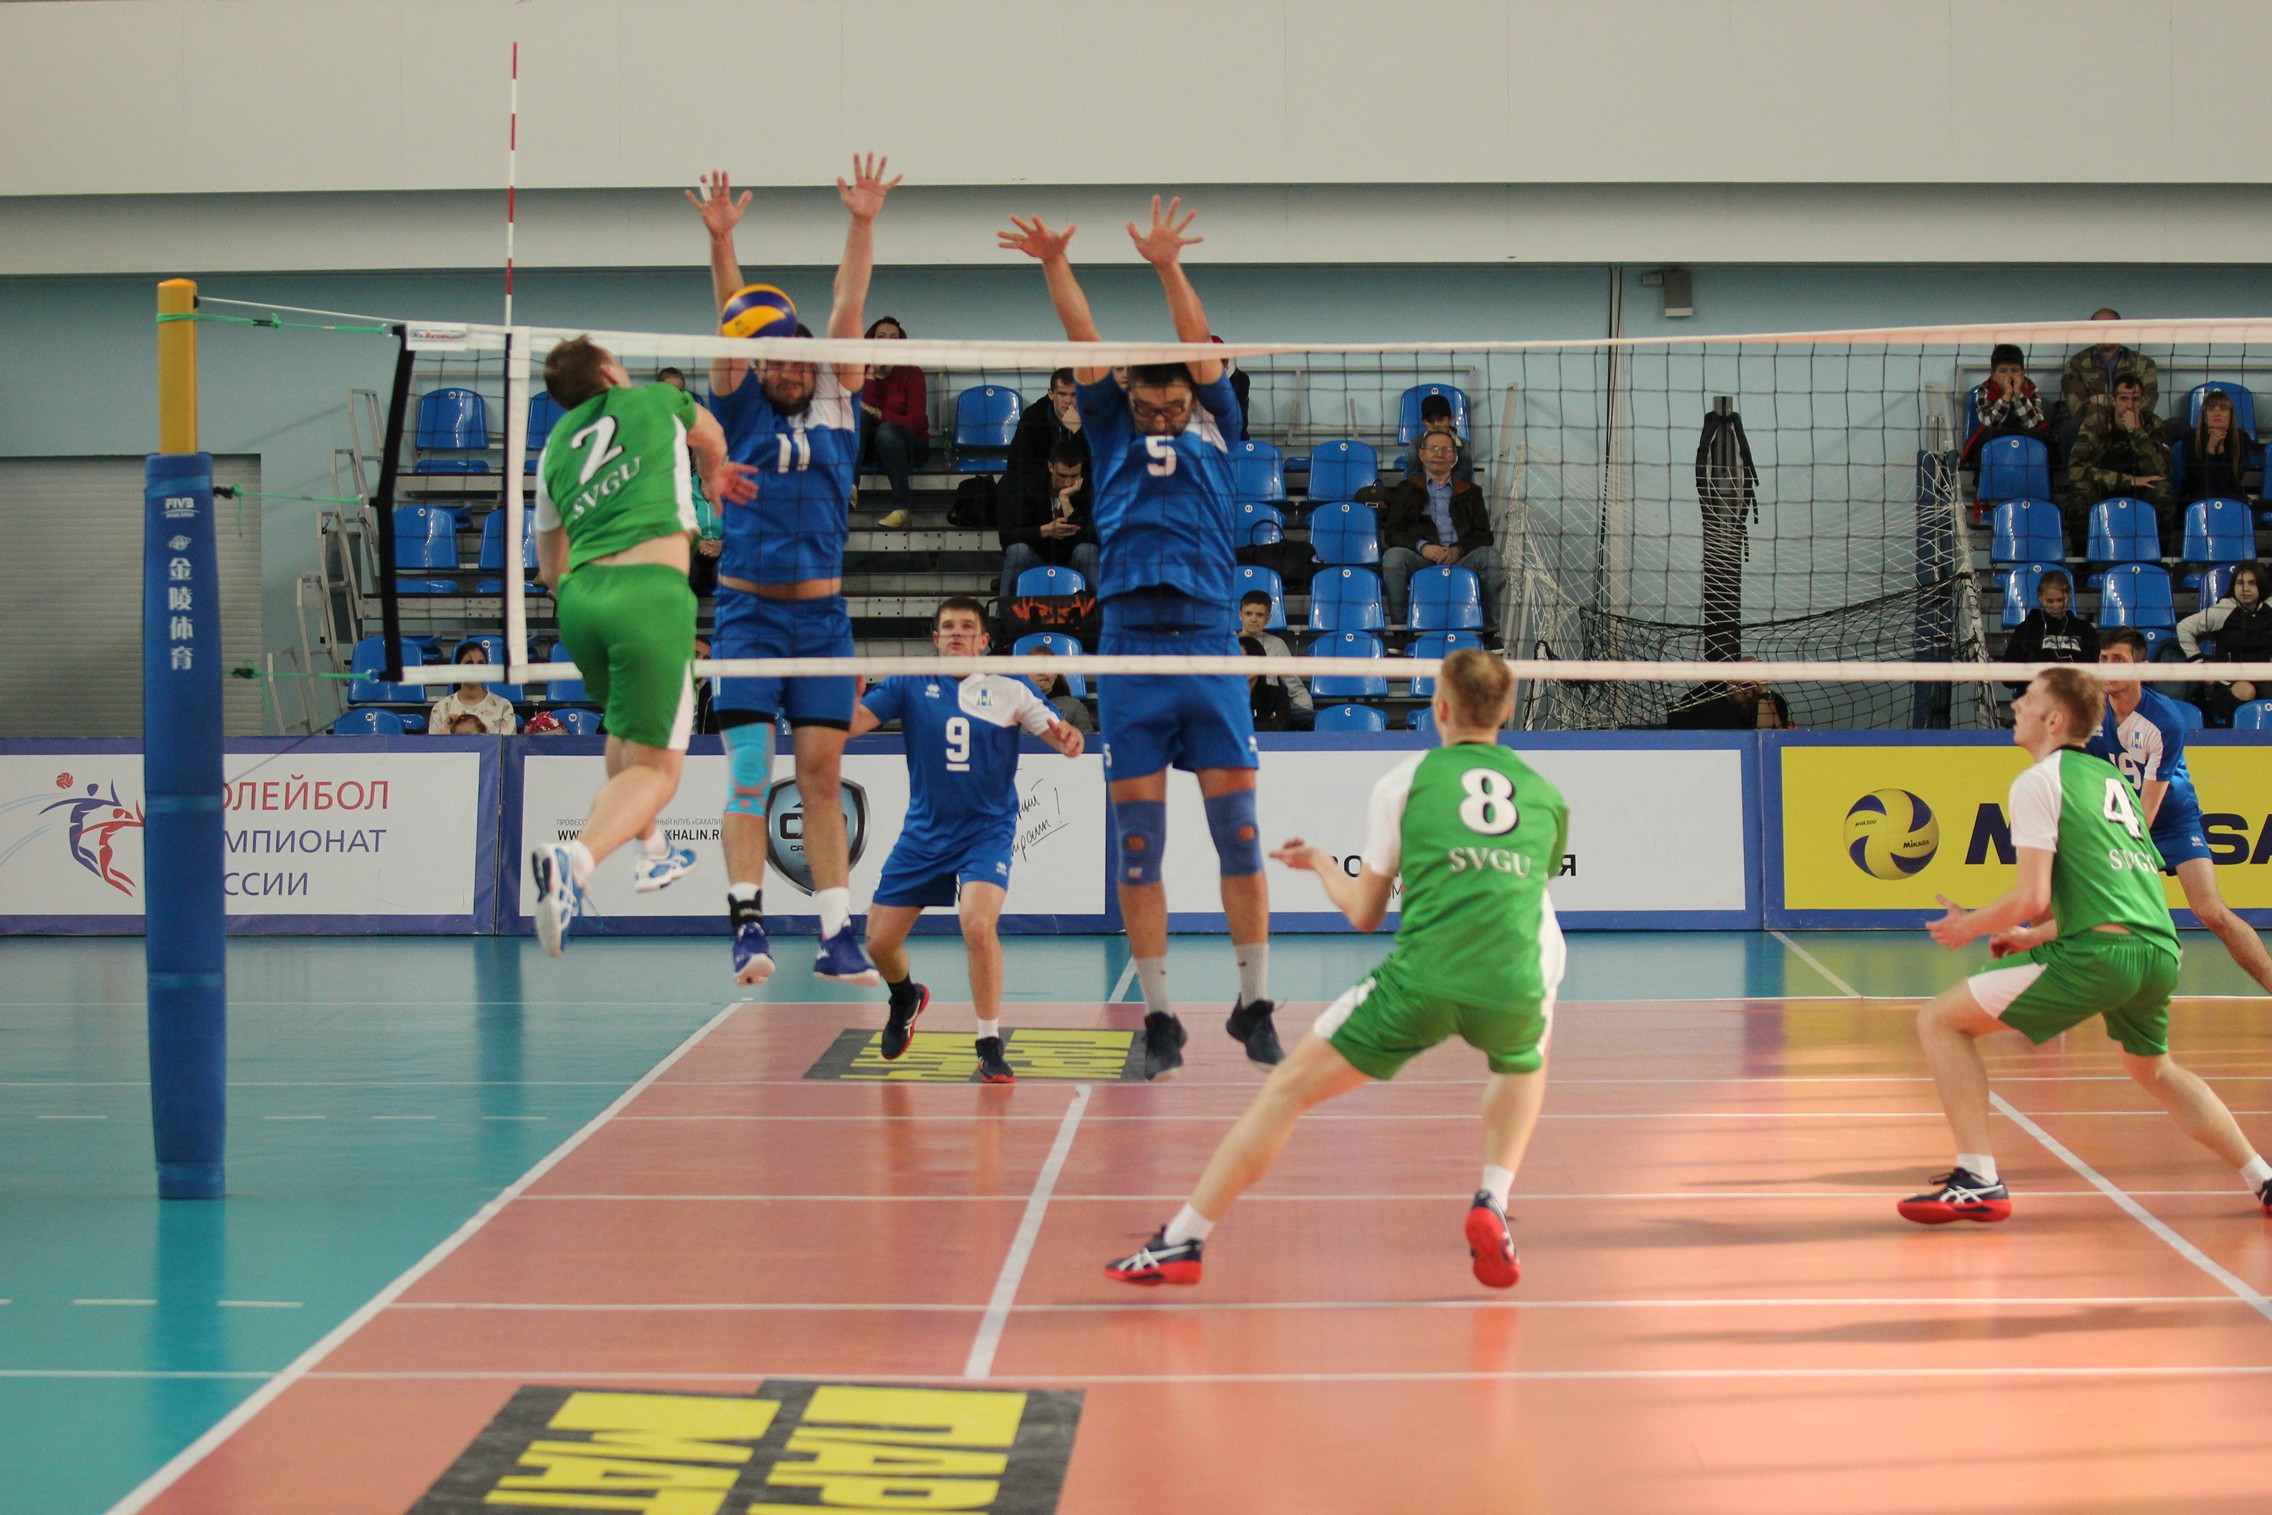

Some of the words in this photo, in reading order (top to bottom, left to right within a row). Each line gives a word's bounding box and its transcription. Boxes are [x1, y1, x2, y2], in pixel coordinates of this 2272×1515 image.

[571, 415, 625, 485] 2
[776, 428, 811, 473] 11
[1145, 435, 1177, 477] 5
[572, 456, 641, 520] SVGU
[945, 716, 970, 762] 9
[224, 774, 389, 811] ЛЕЙБОЛ
[1459, 767, 1519, 836] 8
[2103, 777, 2144, 841] 4
[224, 829, 387, 853] МПИОНАТ
[1448, 846, 1532, 879] SVGU
[224, 872, 309, 896] ССИИ
[746, 1385, 1028, 1515] ПАР
